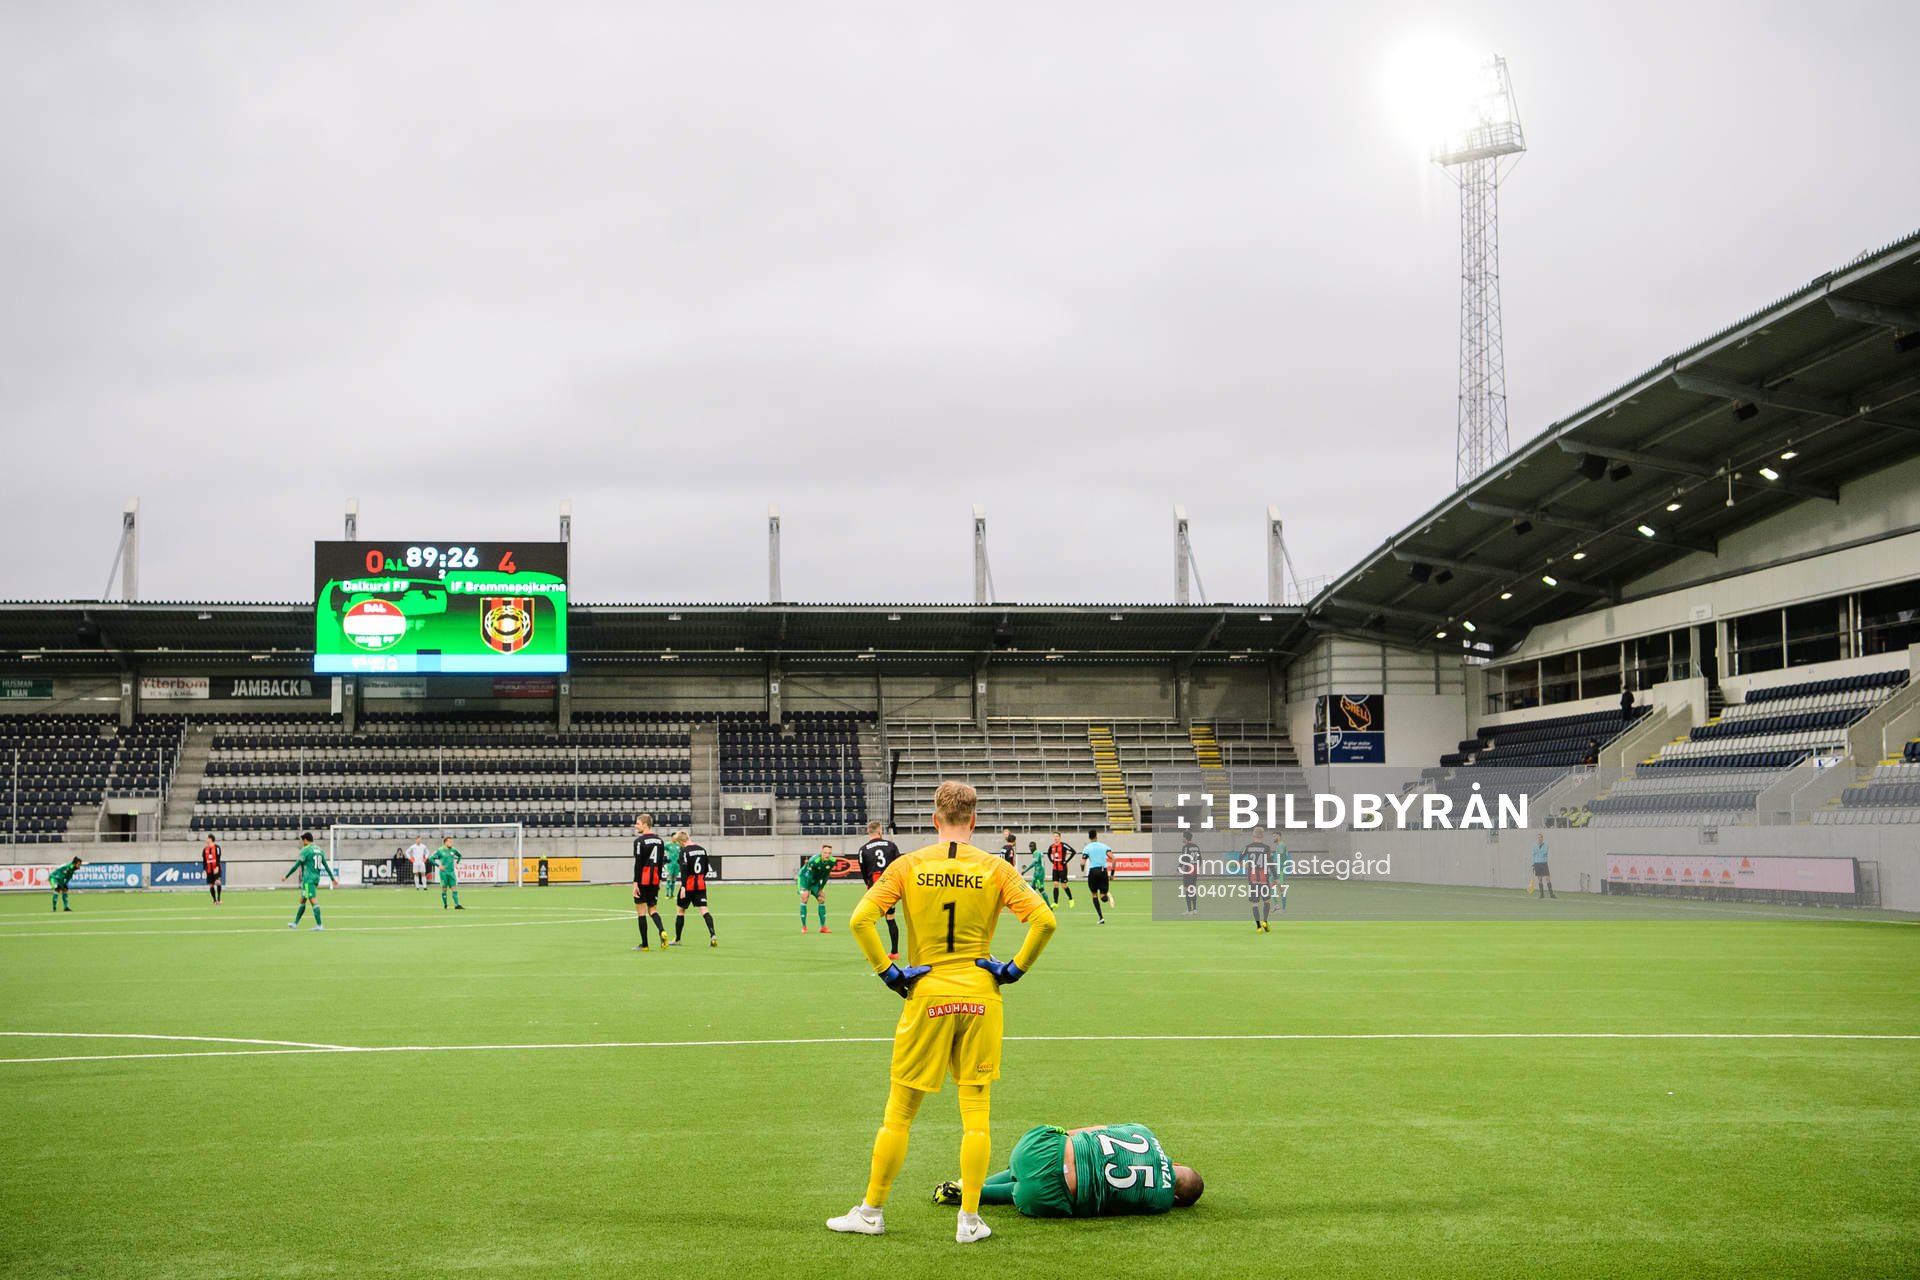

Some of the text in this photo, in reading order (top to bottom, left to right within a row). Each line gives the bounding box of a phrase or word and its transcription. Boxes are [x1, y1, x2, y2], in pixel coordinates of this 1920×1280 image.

[365, 550, 384, 573] 0
[406, 547, 479, 568] 89:26
[498, 551, 516, 574] 4
[343, 580, 390, 592] Dalkurd
[231, 679, 300, 697] JAMBACK
[1345, 702, 1369, 722] SHELL
[650, 846, 658, 863] 4
[875, 849, 886, 867] 3
[694, 857, 701, 873] 6
[916, 872, 983, 889] SERNEKE
[942, 901, 956, 953] 1
[927, 1003, 985, 1018] BAUHAUS
[1096, 1133, 1155, 1190] 25
